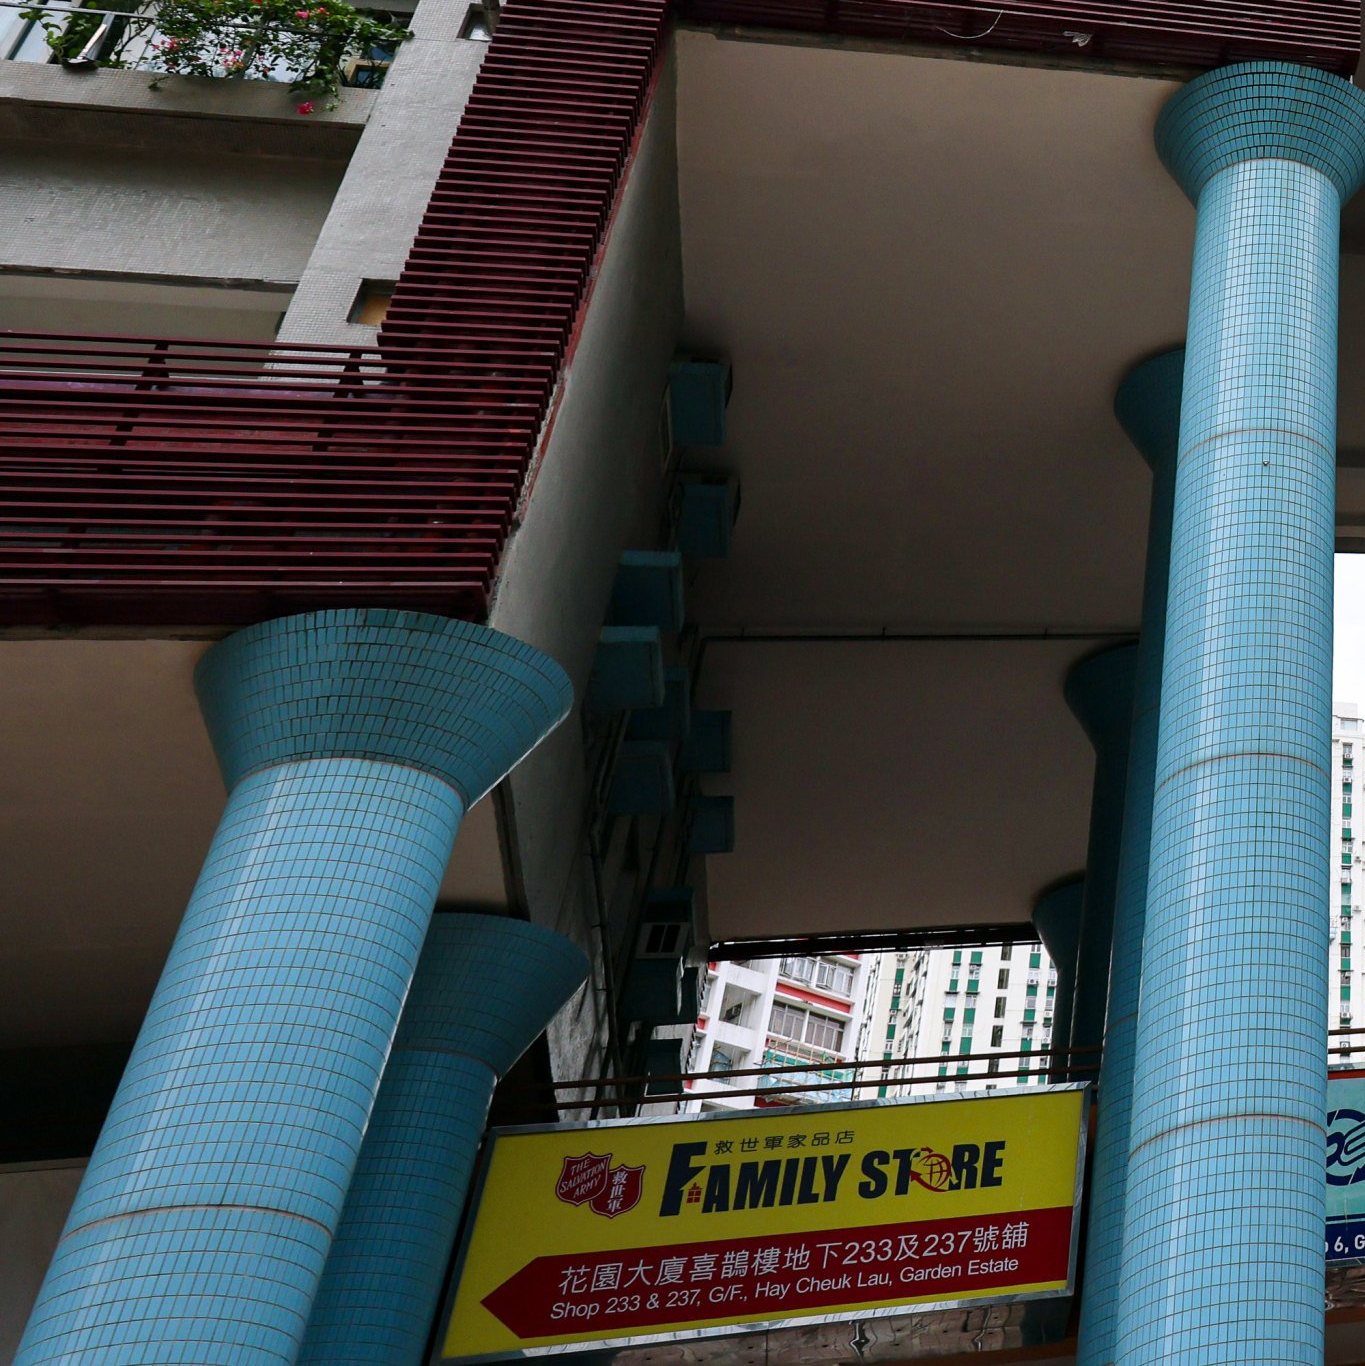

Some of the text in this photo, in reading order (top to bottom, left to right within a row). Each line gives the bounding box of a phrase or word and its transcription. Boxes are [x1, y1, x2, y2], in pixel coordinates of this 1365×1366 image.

[713, 1130, 855, 1155] 救世軍家品店
[559, 1159, 606, 1195] SALVATION
[570, 1157, 591, 1176] THE
[658, 1140, 852, 1217] FAMILY
[573, 1174, 602, 1199] ARMY
[607, 1170, 628, 1212] 救世軍
[1333, 1236, 1349, 1254] 6,
[550, 1300, 600, 1320] Shop
[605, 1294, 641, 1314] 233
[646, 1292, 660, 1310] &
[666, 1288, 701, 1308] 237,
[755, 1280, 791, 1300] Hay
[796, 1273, 852, 1295] Cheuk
[857, 1269, 893, 1288] Lau,
[899, 1260, 962, 1284] Garden
[967, 1256, 1019, 1277] Estate
